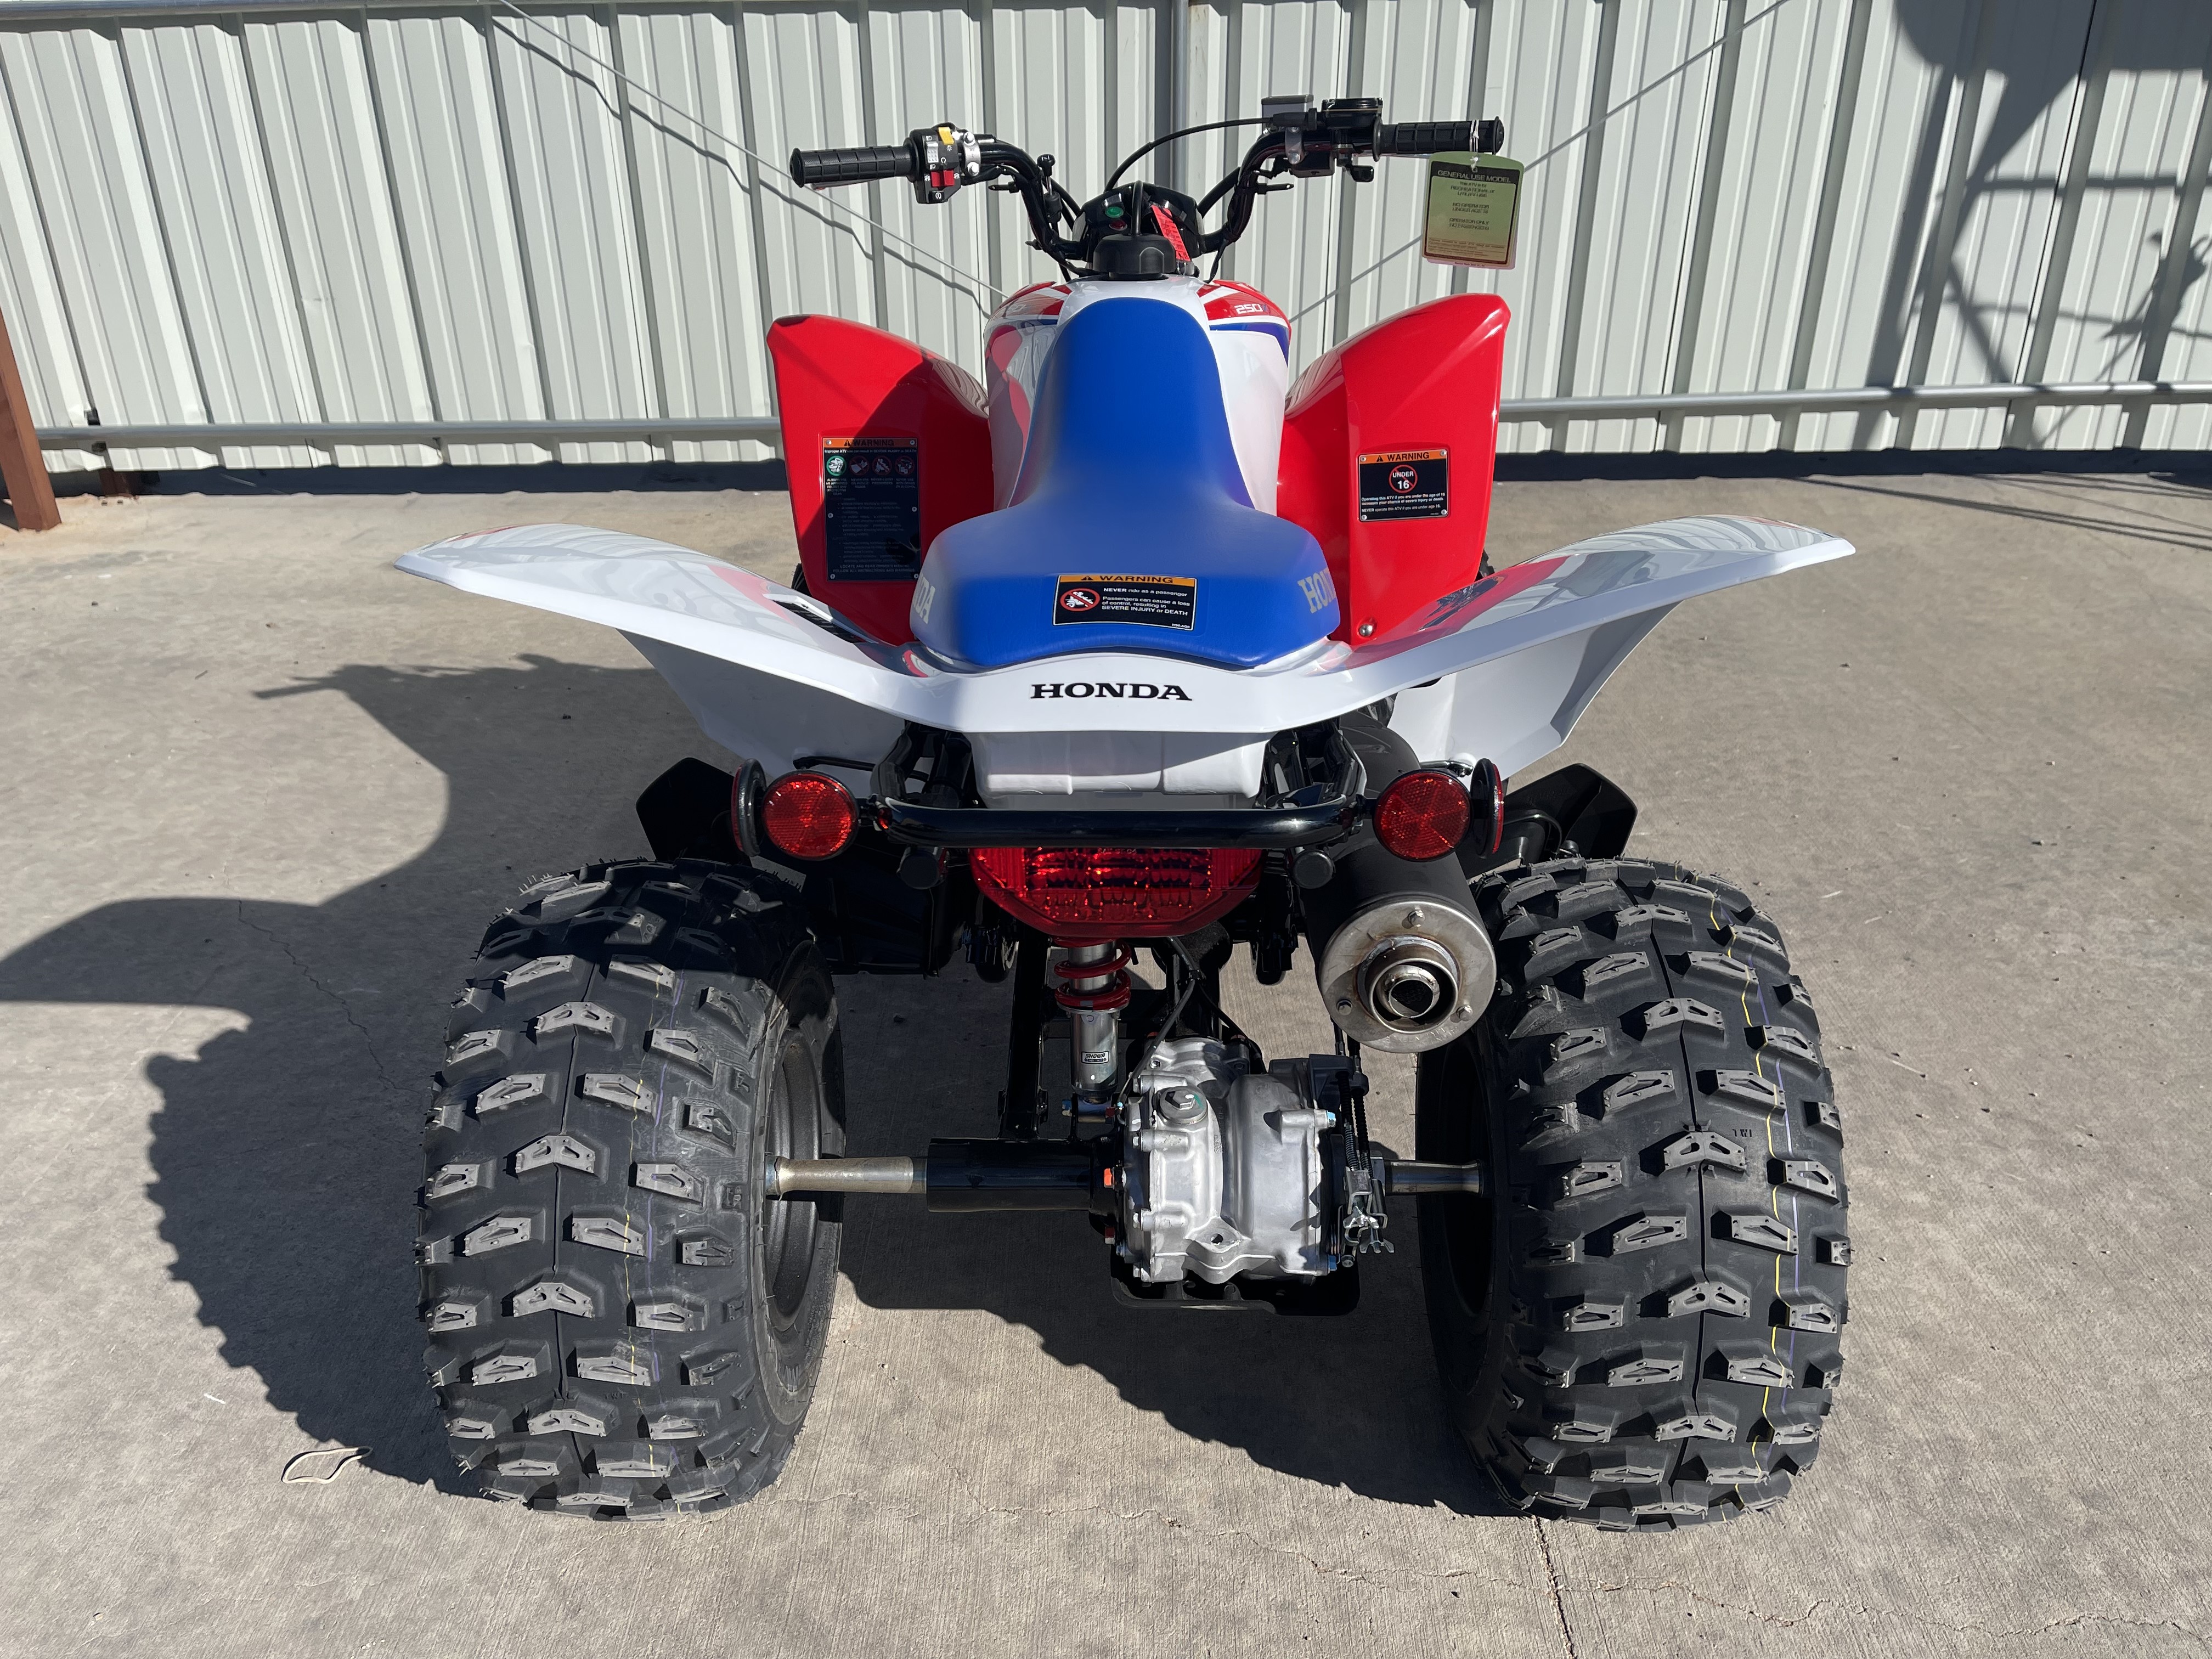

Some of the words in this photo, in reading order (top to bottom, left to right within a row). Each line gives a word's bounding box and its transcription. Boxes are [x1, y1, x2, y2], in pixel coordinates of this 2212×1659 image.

[1437, 170, 1470, 179] GENERAL
[1234, 303, 1263, 314] 250
[1387, 452, 1430, 461] WARNING
[1397, 479, 1409, 489] 16
[1099, 575, 1173, 584] WARNING
[1030, 682, 1193, 701] HONDA
